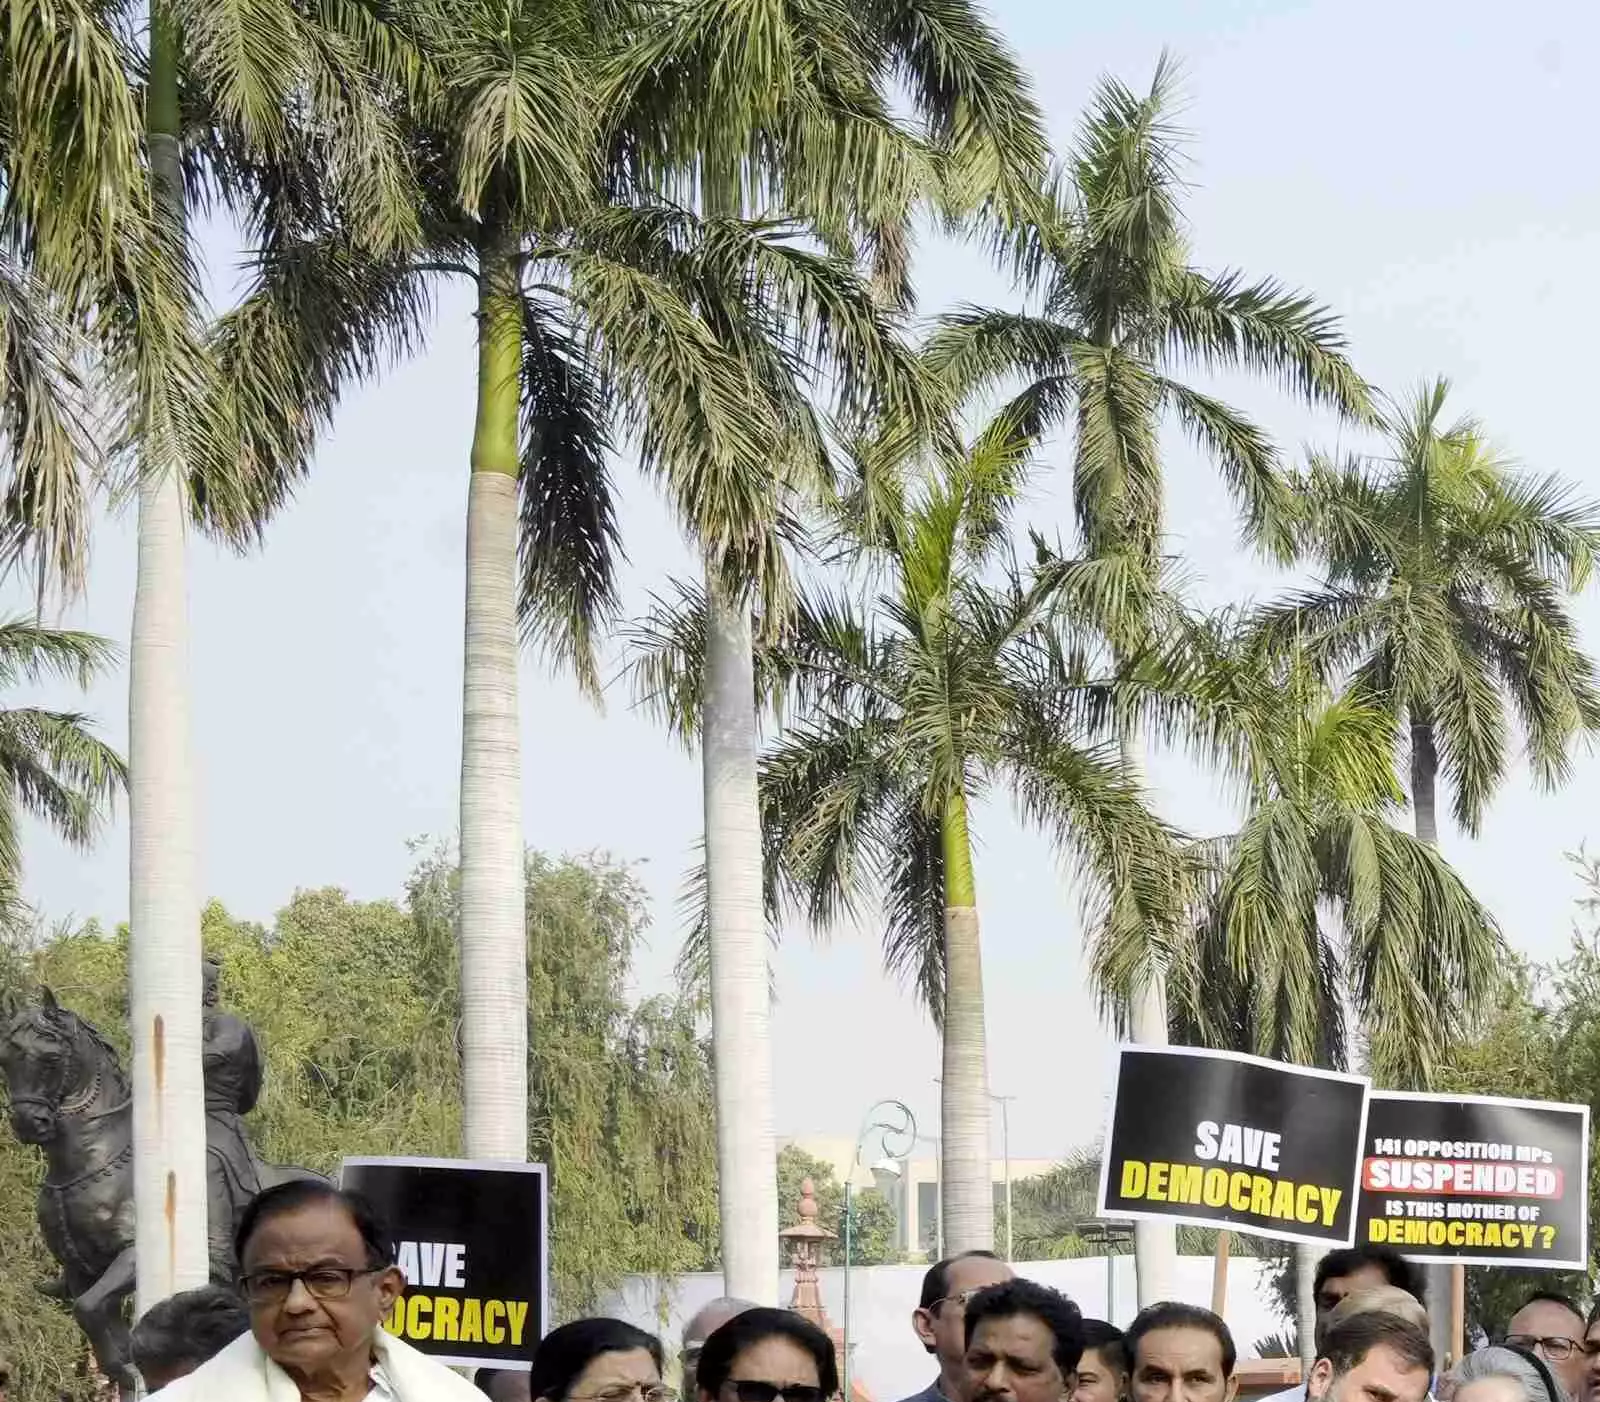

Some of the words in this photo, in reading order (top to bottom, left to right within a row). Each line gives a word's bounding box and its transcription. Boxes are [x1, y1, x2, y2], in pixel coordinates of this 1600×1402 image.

[1195, 1120, 1281, 1172] SAVE
[1374, 1138, 1401, 1155] 141
[1403, 1140, 1513, 1161] OPPOSITION
[1120, 1160, 1342, 1226] DEMOCRACY
[1369, 1159, 1557, 1195] SUSPENDED
[1385, 1200, 1404, 1217] IS
[1407, 1201, 1446, 1218] THIS
[1447, 1203, 1517, 1220] MOTHER
[1518, 1205, 1541, 1221] OF
[392, 1241, 466, 1288] AVE
